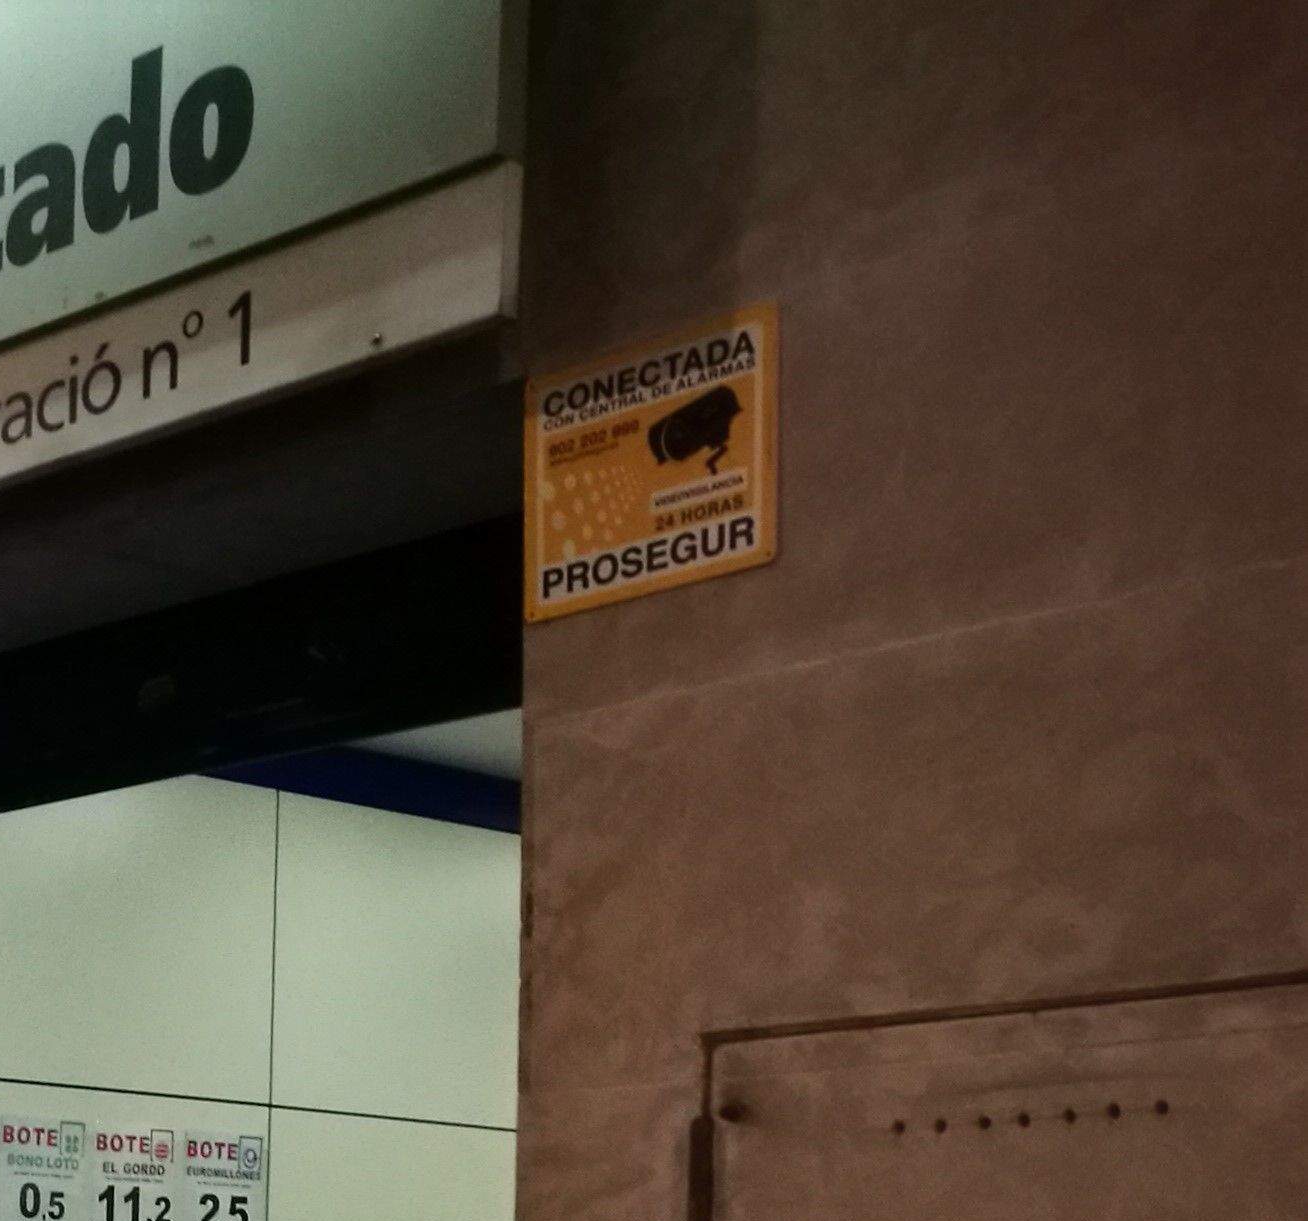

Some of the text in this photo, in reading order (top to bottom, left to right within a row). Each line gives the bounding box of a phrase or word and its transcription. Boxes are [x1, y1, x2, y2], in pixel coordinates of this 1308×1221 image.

[228, 291, 253, 366] 1
[543, 331, 756, 418] CONECTADA
[544, 354, 756, 431] CON CENTRAL DE ALARMAS
[681, 494, 744, 524] HORAS
[543, 516, 755, 599] PROSEGUR
[2, 1125, 59, 1147] BOTE
[96, 1132, 152, 1154] BOTE
[187, 1140, 239, 1161] BOTE
[102, 1162, 166, 1176] EL GORDO
[187, 1167, 262, 1181] EUROMILLONES
[19, 1182, 66, 1221] 0,5
